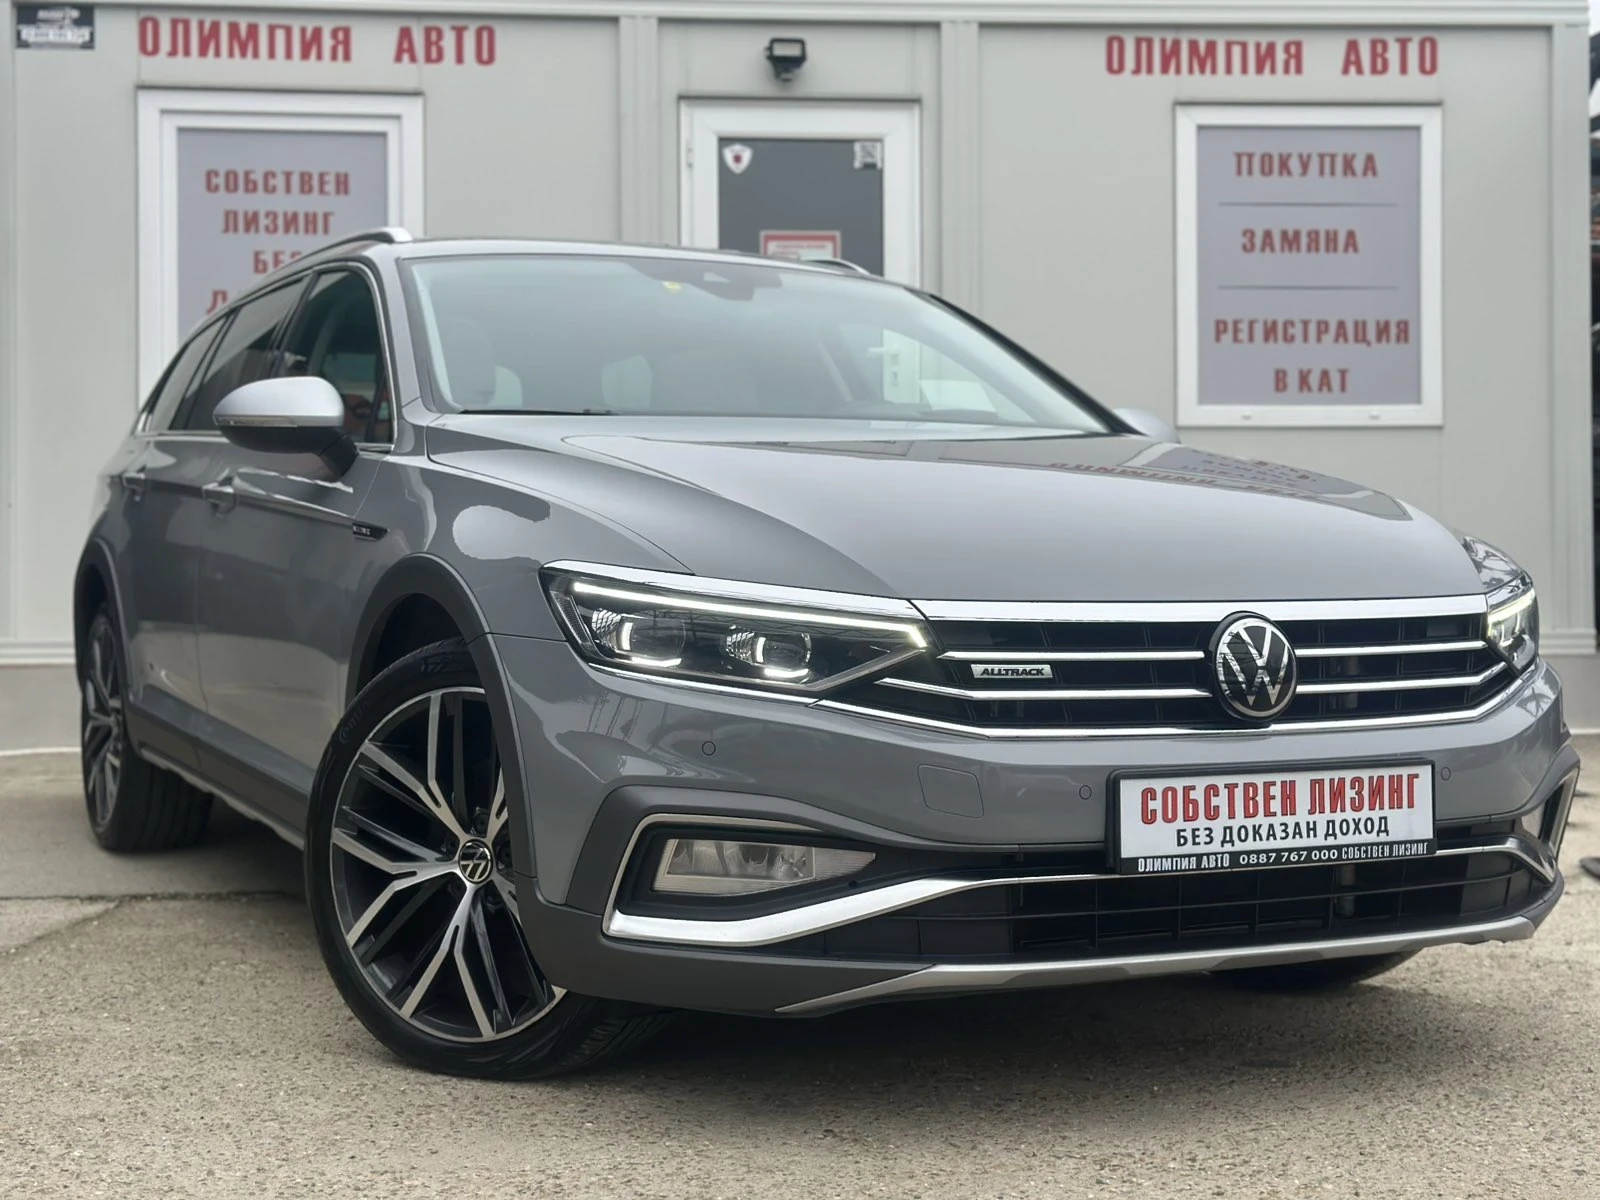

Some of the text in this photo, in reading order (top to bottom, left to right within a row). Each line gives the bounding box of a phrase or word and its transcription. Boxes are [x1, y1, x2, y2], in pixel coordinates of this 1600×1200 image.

[138, 17, 352, 63] ОЛИМПИЯ
[394, 24, 496, 67] АВТО
[1106, 35, 1438, 77] ОЛИМПИЯ АВТО
[1234, 151, 1379, 177] ПОКУПКА
[205, 170, 351, 196] СОБСТВЕН
[222, 210, 335, 235] ЛИЗИНГ
[1241, 228, 1360, 254] ЗАМЯНА
[1214, 318, 1411, 346] РЕГИСТРАЦИЯ
[1274, 368, 1350, 394] В КАТ
[980, 667, 1045, 677] ALLTRACK
[1141, 773, 1420, 825] СОБСТВЕН ЛИЗИНГ
[1176, 815, 1390, 848] БЕЗ ДОКАЗАН ДОХОД
[1138, 841, 1429, 873] ОЛИМПИЯ АВТО 0887 767 000 СОБСТВЕН ЛИЗИНГ
